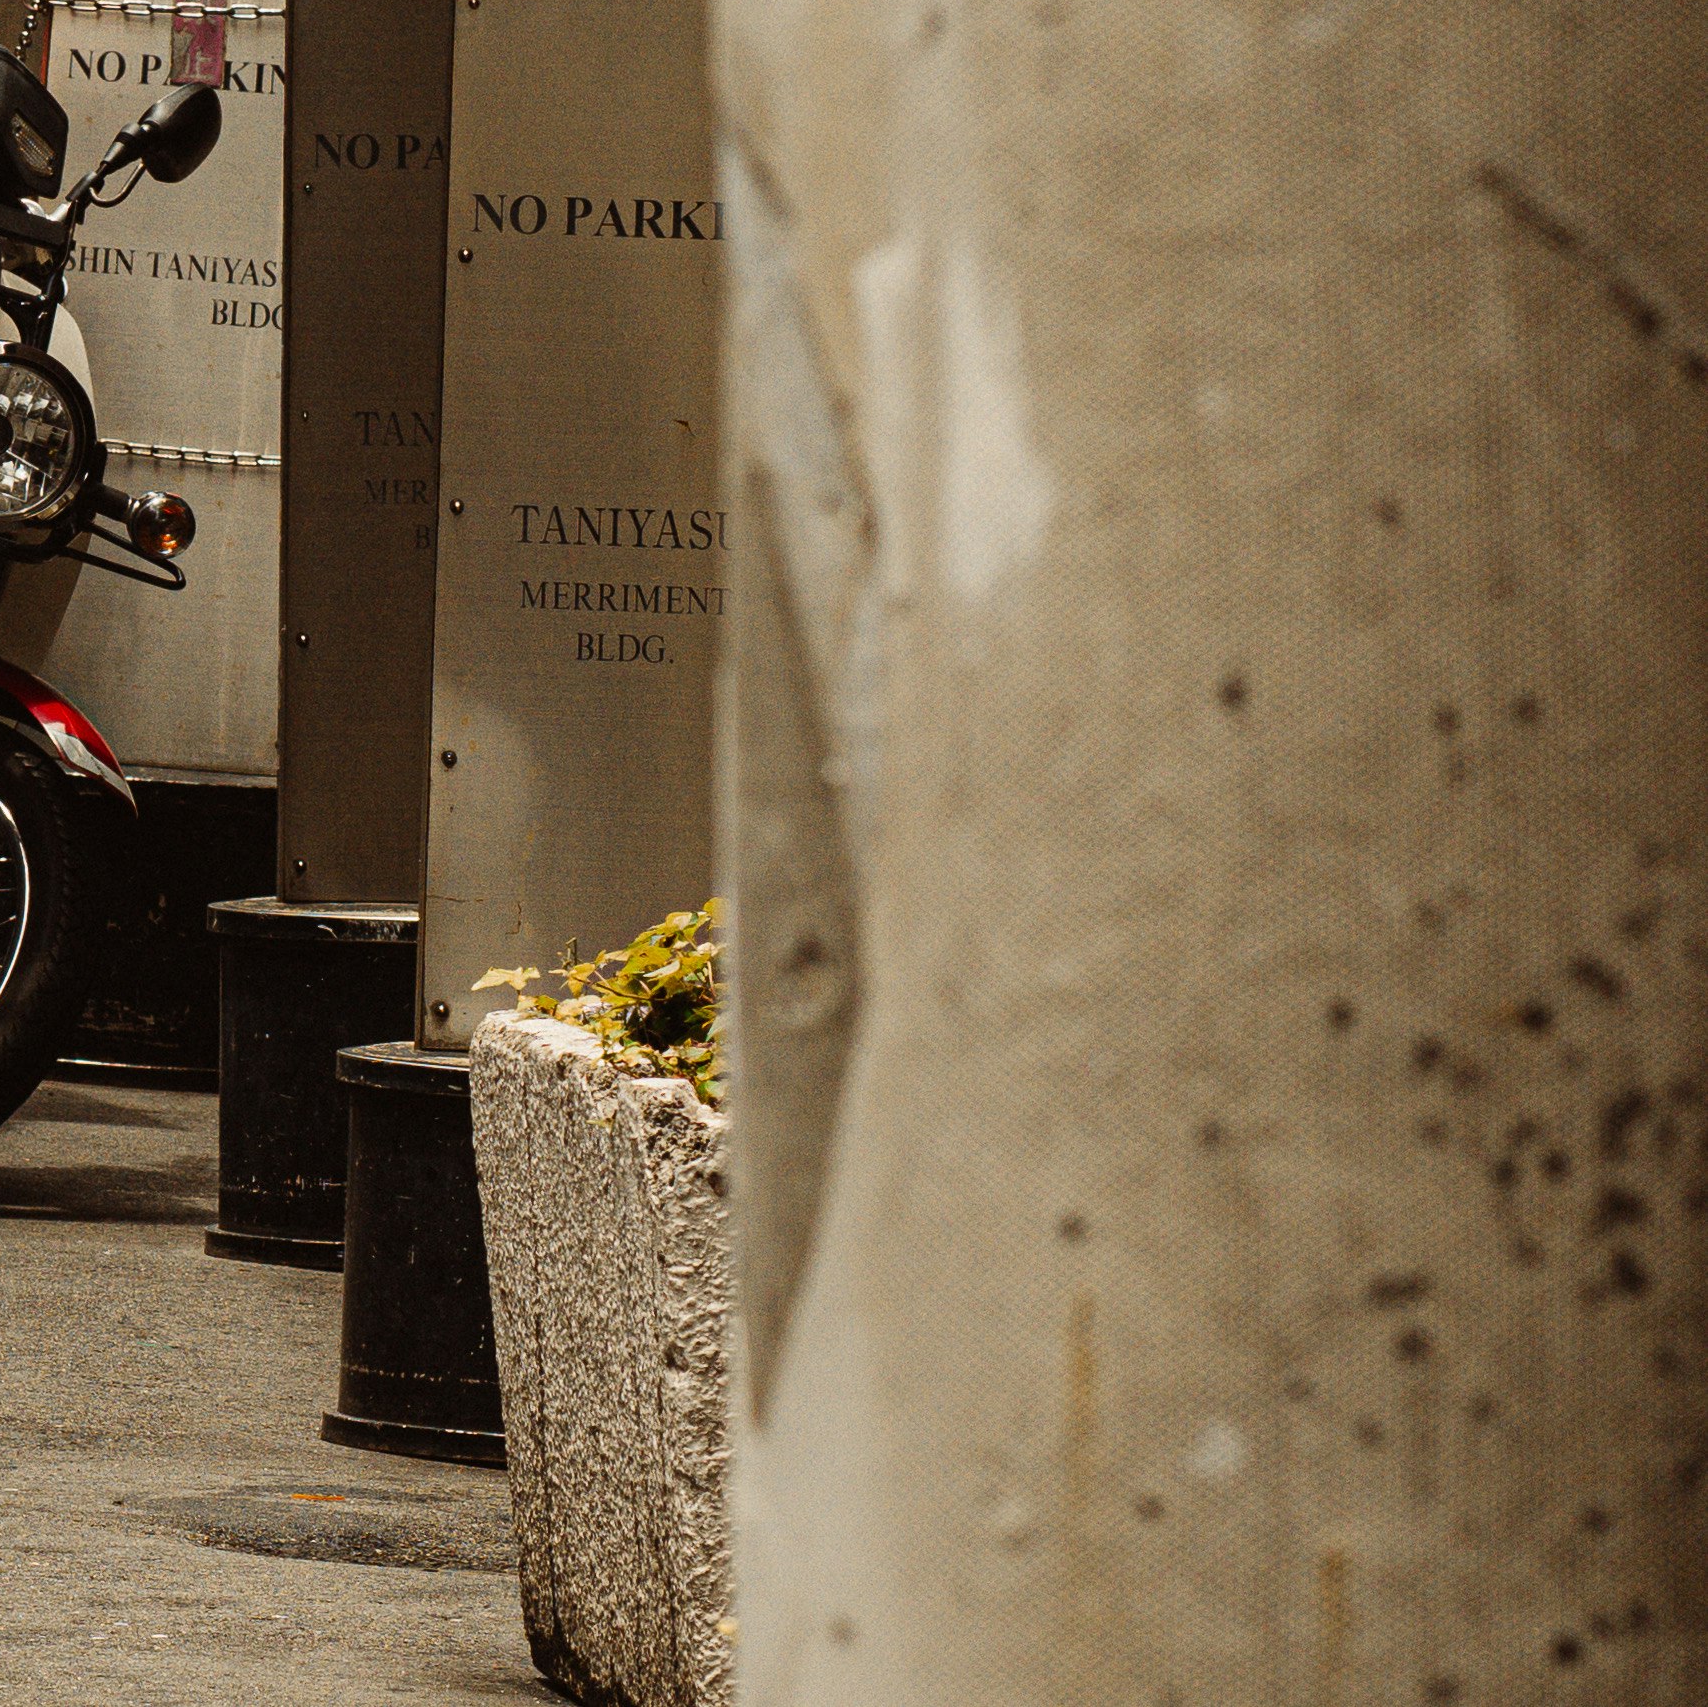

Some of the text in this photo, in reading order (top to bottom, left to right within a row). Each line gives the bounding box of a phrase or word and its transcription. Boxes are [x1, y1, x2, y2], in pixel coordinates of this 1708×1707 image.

[68, 49, 284, 96] NO PKIN
[314, 133, 380, 170] NO
[471, 193, 547, 235] NO
[520, 580, 731, 616] MERRIMENT
[575, 632, 674, 665] BLDG.
